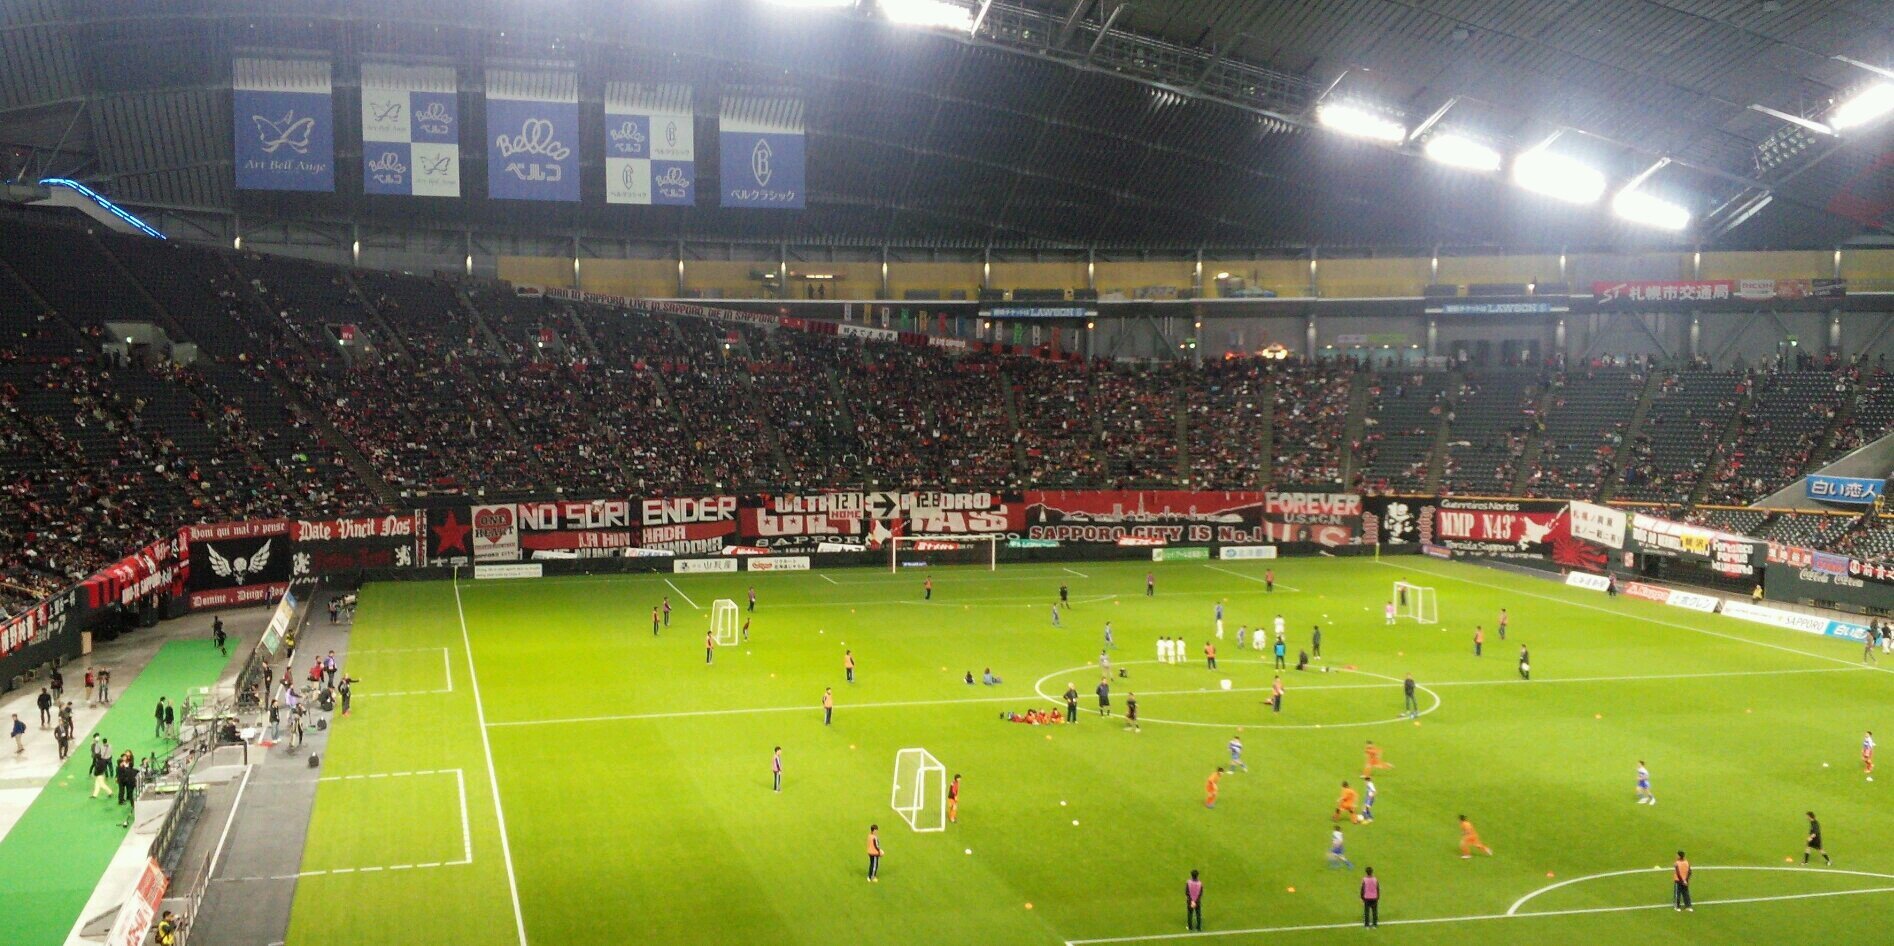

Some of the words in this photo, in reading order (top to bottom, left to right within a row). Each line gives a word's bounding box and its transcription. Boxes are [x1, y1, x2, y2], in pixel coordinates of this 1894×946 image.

[496, 118, 570, 160] Bellco
[244, 160, 265, 169] Art
[270, 160, 292, 170] Bell
[296, 161, 326, 174] Ange
[504, 162, 562, 181] ベルコ
[731, 190, 795, 201] ベルクラシック
[1628, 284, 1729, 301] 札幌市交通局
[1811, 480, 1876, 498] 白い恋人
[1264, 493, 1361, 516] FOREVER
[519, 502, 558, 530] NO
[831, 511, 861, 519] HOME
[297, 519, 332, 542] Date
[336, 518, 375, 539] Vincit
[380, 515, 411, 537] Nos
[475, 526, 514, 538] HEART
[1441, 512, 1474, 537] MMP
[578, 531, 598, 548] LA
[1029, 525, 1127, 542] SAPPORO
[1132, 525, 1183, 541] CITY
[1187, 525, 1211, 541] IS
[1785, 616, 1825, 631] SAPPORO
